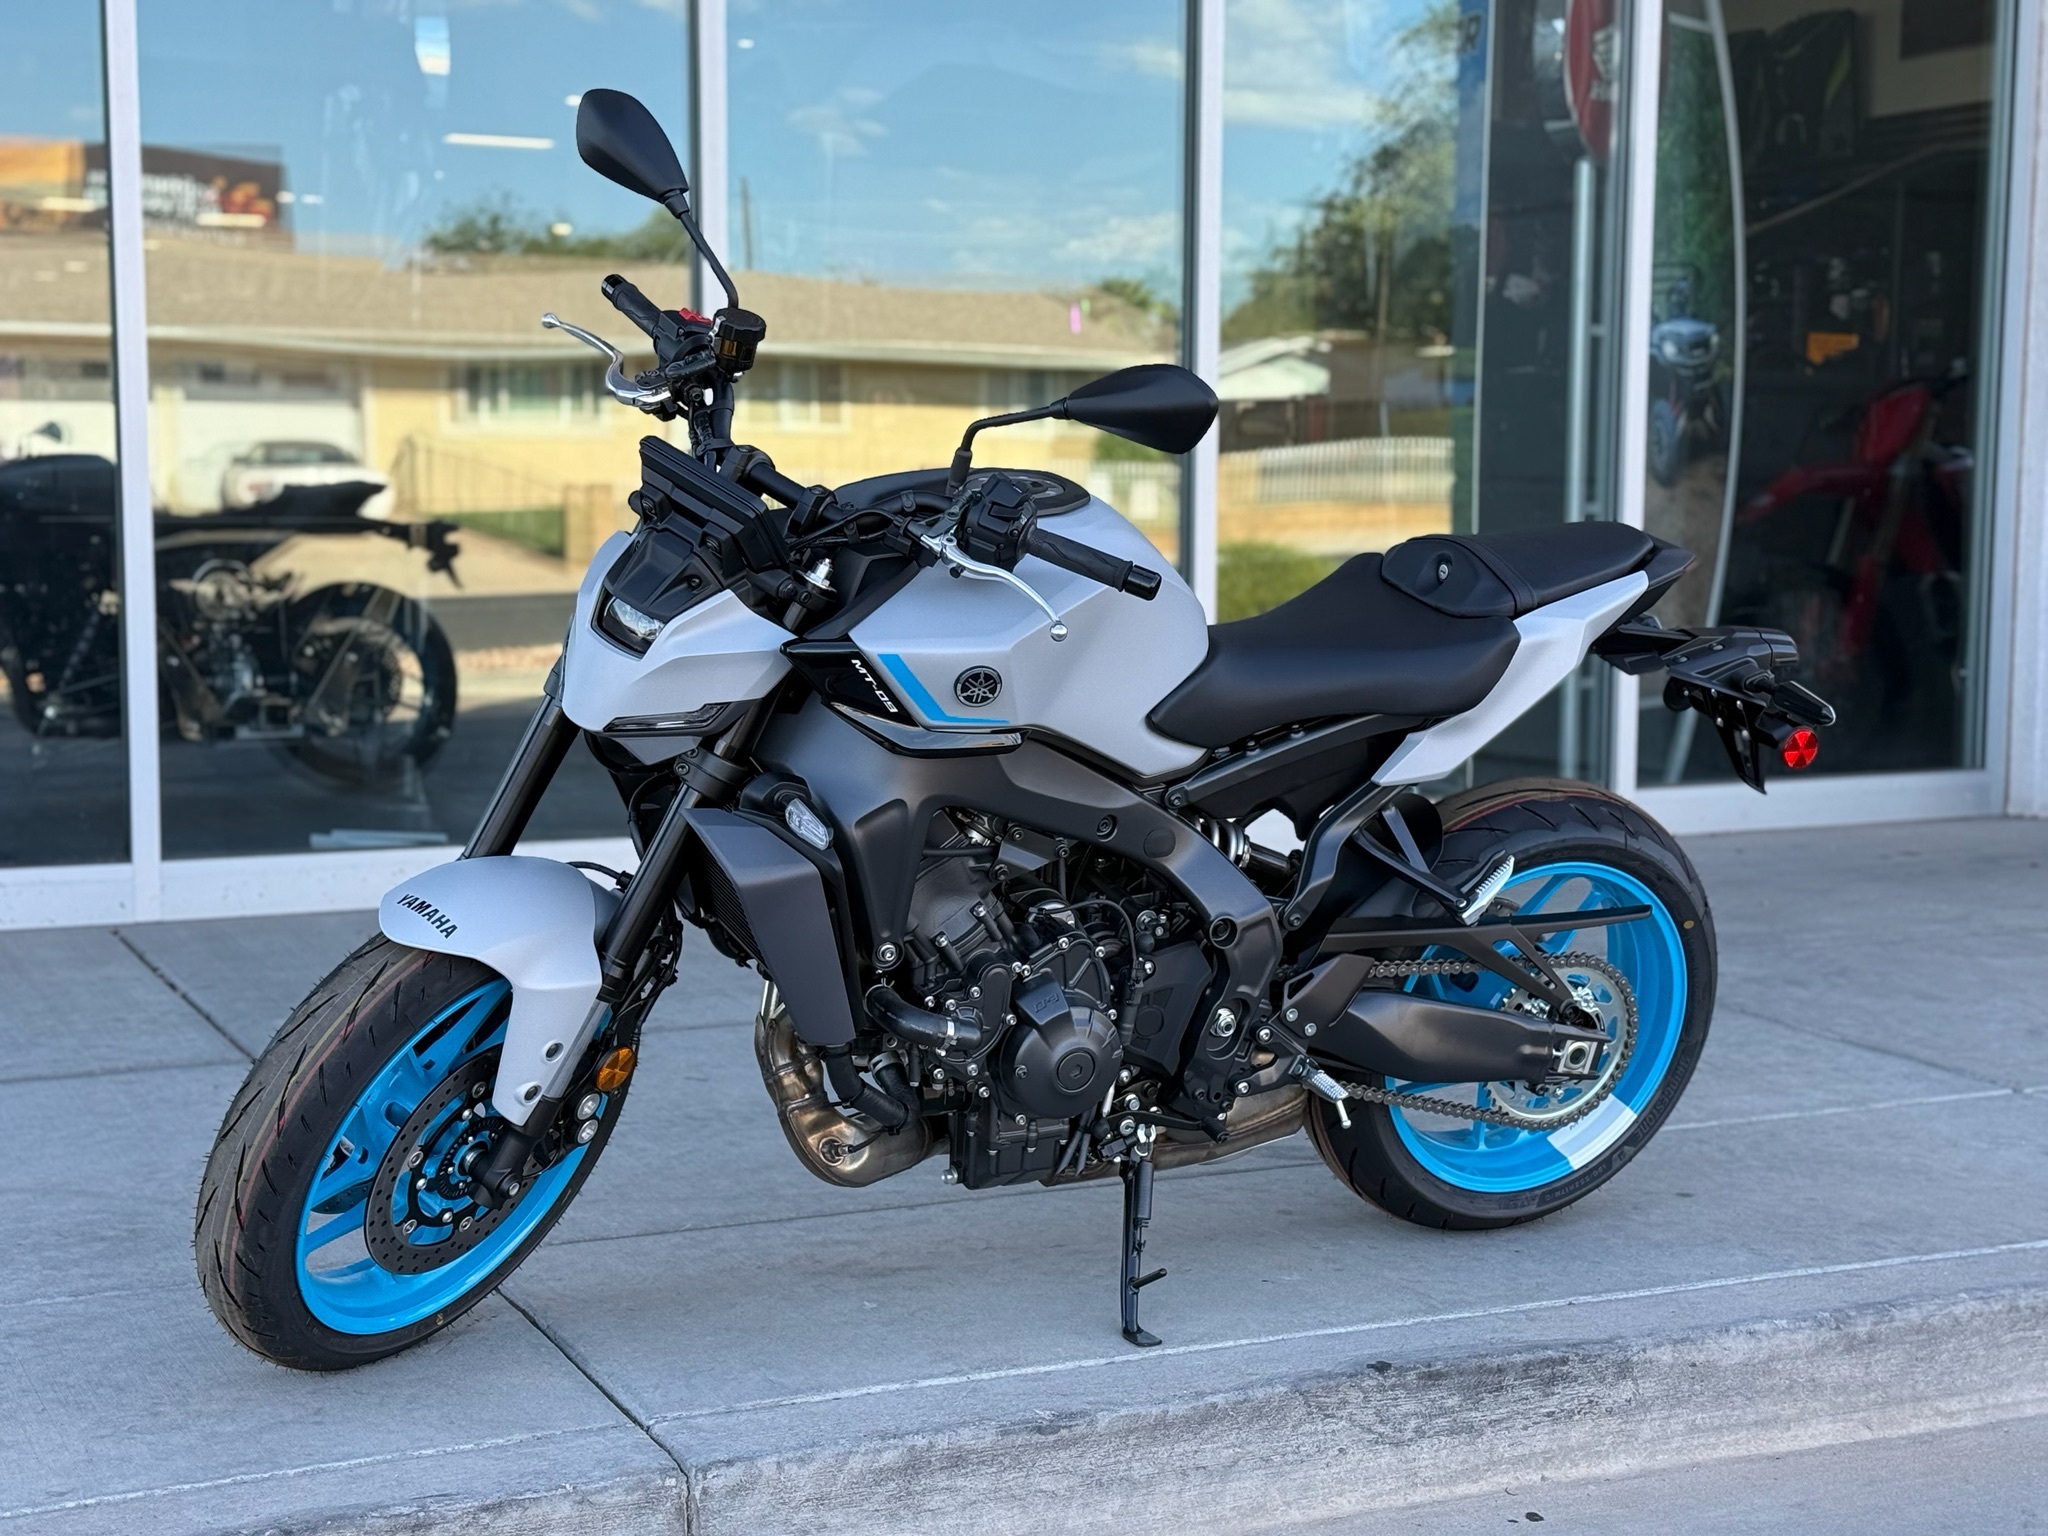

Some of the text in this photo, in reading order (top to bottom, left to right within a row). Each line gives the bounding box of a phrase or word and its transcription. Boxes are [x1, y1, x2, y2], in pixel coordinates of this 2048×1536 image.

[851, 659, 899, 713] MT-09
[396, 893, 458, 939] YAMAHA
[1634, 1057, 1692, 1138] BRIDGESTONE
